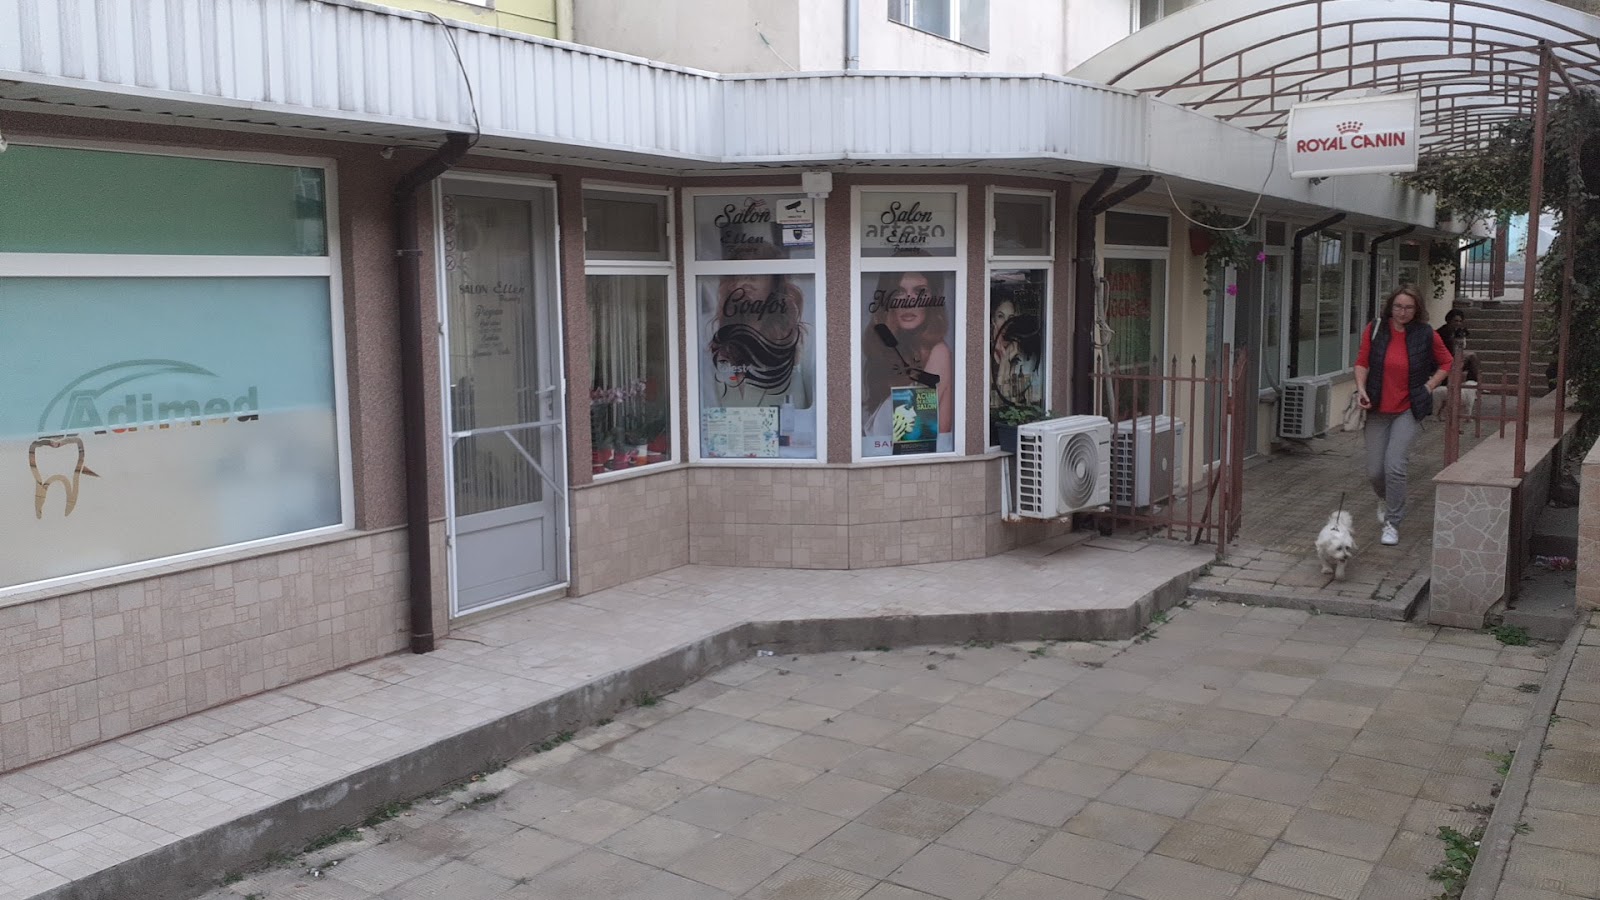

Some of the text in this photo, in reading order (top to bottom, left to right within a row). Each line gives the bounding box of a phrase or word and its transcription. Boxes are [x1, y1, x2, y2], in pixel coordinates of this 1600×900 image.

[1296, 132, 1405, 153] ROYAL CANIN
[714, 203, 771, 228] Salon
[881, 201, 933, 224] Salon
[720, 230, 764, 244] Ellen
[886, 229, 926, 243] Ellen
[459, 281, 525, 294] SALON Ellen
[723, 287, 787, 321] Coafor
[868, 288, 946, 313] Manichiura
[62, 386, 258, 436] Adimed
